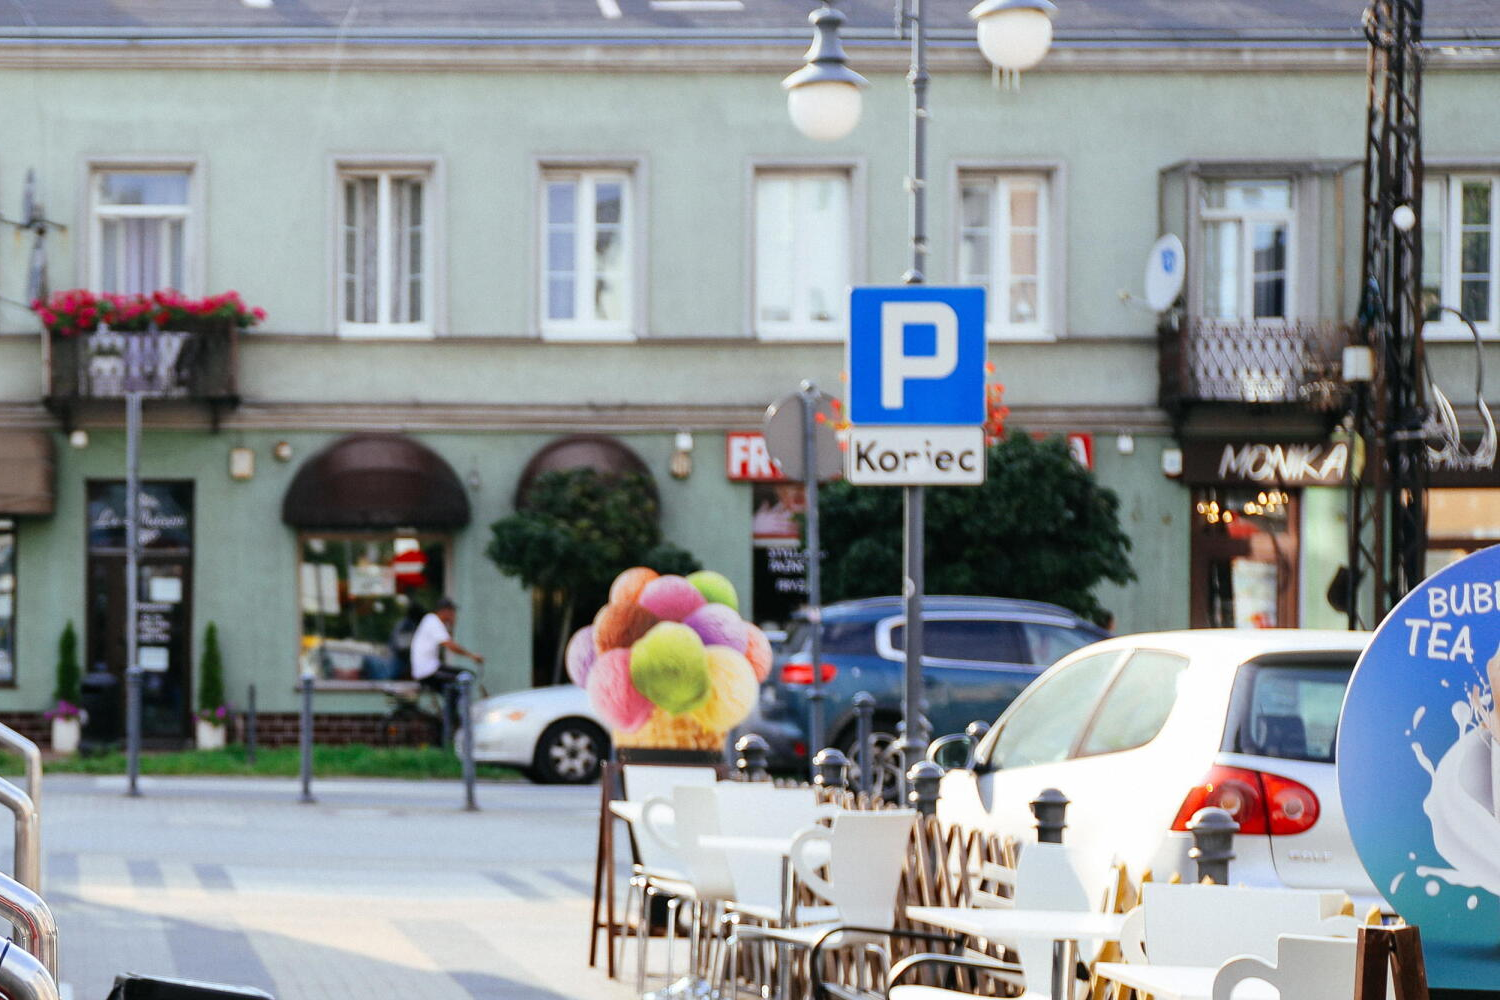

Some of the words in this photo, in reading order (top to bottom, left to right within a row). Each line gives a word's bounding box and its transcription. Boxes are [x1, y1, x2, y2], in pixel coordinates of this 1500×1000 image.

[881, 301, 959, 410] P
[1218, 443, 1348, 481] MONIKA
[1405, 618, 1474, 664] TEA
